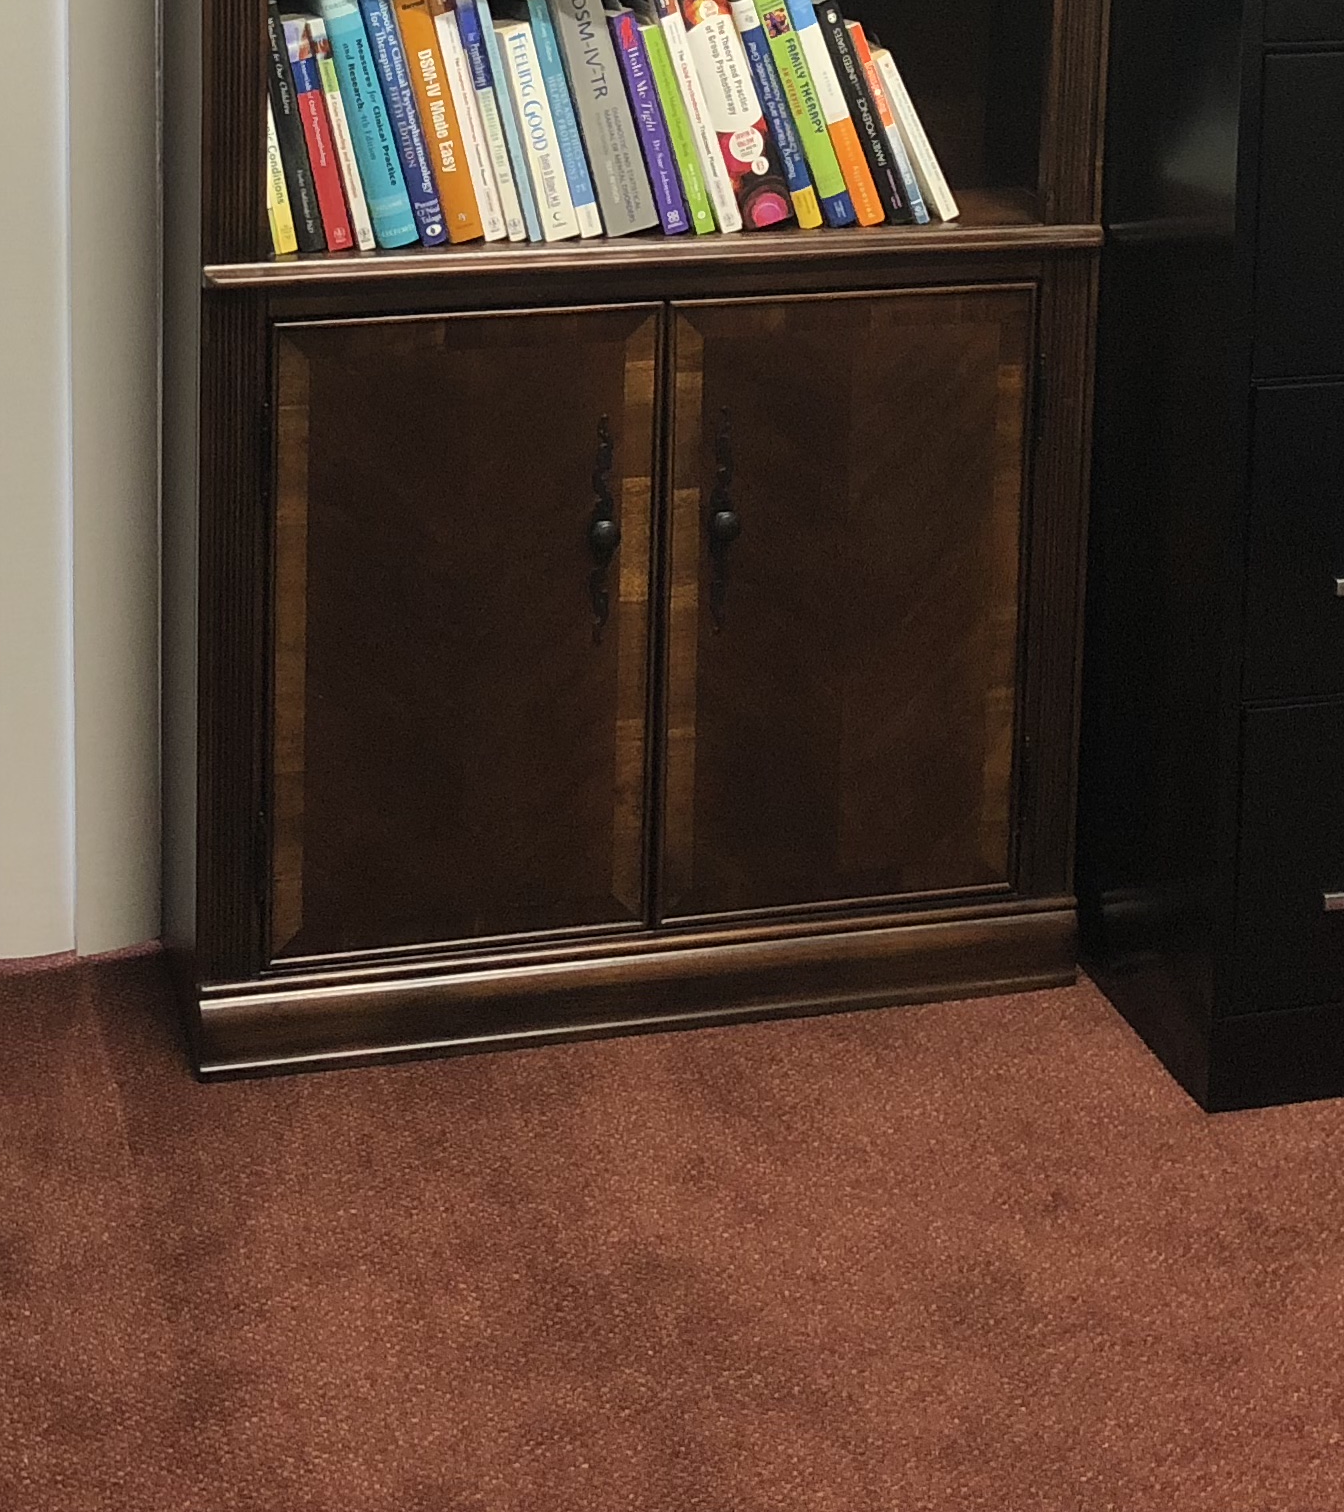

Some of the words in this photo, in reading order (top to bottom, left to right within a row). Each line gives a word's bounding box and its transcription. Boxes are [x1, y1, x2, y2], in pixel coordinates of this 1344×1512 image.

[368, 10, 382, 26] for
[704, 24, 714, 34] of
[715, 20, 727, 35] The
[341, 42, 353, 61] and
[372, 30, 395, 81] Therapists
[386, 34, 397, 46] of
[676, 49, 685, 62] The
[706, 34, 721, 59] Group
[718, 35, 734, 63] Theory
[747, 40, 761, 62] Grief
[832, 27, 848, 54] STATES
[274, 63, 285, 80] Our
[300, 59, 312, 91] Essentials
[354, 38, 372, 87] Measures
[389, 46, 408, 87] Clinical
[416, 48, 441, 97] DSM-IV
[467, 42, 487, 87] Psychotherapy
[507, 31, 539, 97] FEELING
[626, 46, 644, 77] Hold
[680, 62, 690, 79] Child
[728, 63, 739, 78] and
[841, 54, 859, 83] UNITED
[346, 62, 366, 112] Research,
[366, 89, 378, 104] for
[634, 80, 649, 99] Me
[712, 59, 737, 116] Psychotherapy
[733, 79, 749, 113] Practice
[754, 62, 772, 100] Traumatic
[785, 37, 806, 79] FAMILY
[798, 80, 824, 135] THERAPY
[278, 81, 292, 115] Children
[308, 99, 317, 115] Child
[388, 85, 404, 118] FIFTH
[684, 79, 703, 124] Psychotherapy
[766, 100, 778, 117] and
[777, 102, 788, 121] and
[371, 104, 387, 142] Clinical
[428, 100, 451, 138] Made
[521, 98, 552, 152] GOOD
[546, 75, 563, 117] HELPING
[556, 118, 578, 181] PROFESSIONS
[563, 105, 574, 125] AND
[602, 109, 616, 142] MANUAL
[610, 106, 628, 151] DIAGNOSTIC
[638, 100, 659, 133] Tight
[856, 96, 878, 138] VIOLENCE
[310, 115, 327, 167] Psychopathology
[363, 129, 377, 161] Edition
[397, 120, 417, 168] EDITION
[398, 88, 435, 194] Psychopharmacology
[568, 127, 583, 159] ETHICS
[610, 142, 619, 153] OF
[698, 124, 712, 155] Treatment
[771, 117, 787, 147] Trauma
[783, 121, 798, 152] Children
[342, 150, 350, 162] and
[381, 144, 398, 186] Practice
[435, 140, 459, 174] Easy
[613, 153, 627, 183] MENTAL
[621, 150, 632, 167] AND
[707, 155, 719, 178] Planner
[780, 146, 798, 179] Treating
[870, 138, 888, 166] FAMILY
[266, 144, 285, 204] Conditions
[626, 168, 643, 210] STATISTICAL
[658, 169, 675, 204] Johnson
[620, 183, 636, 222] DISORDERS
[850, 163, 876, 218] personality
